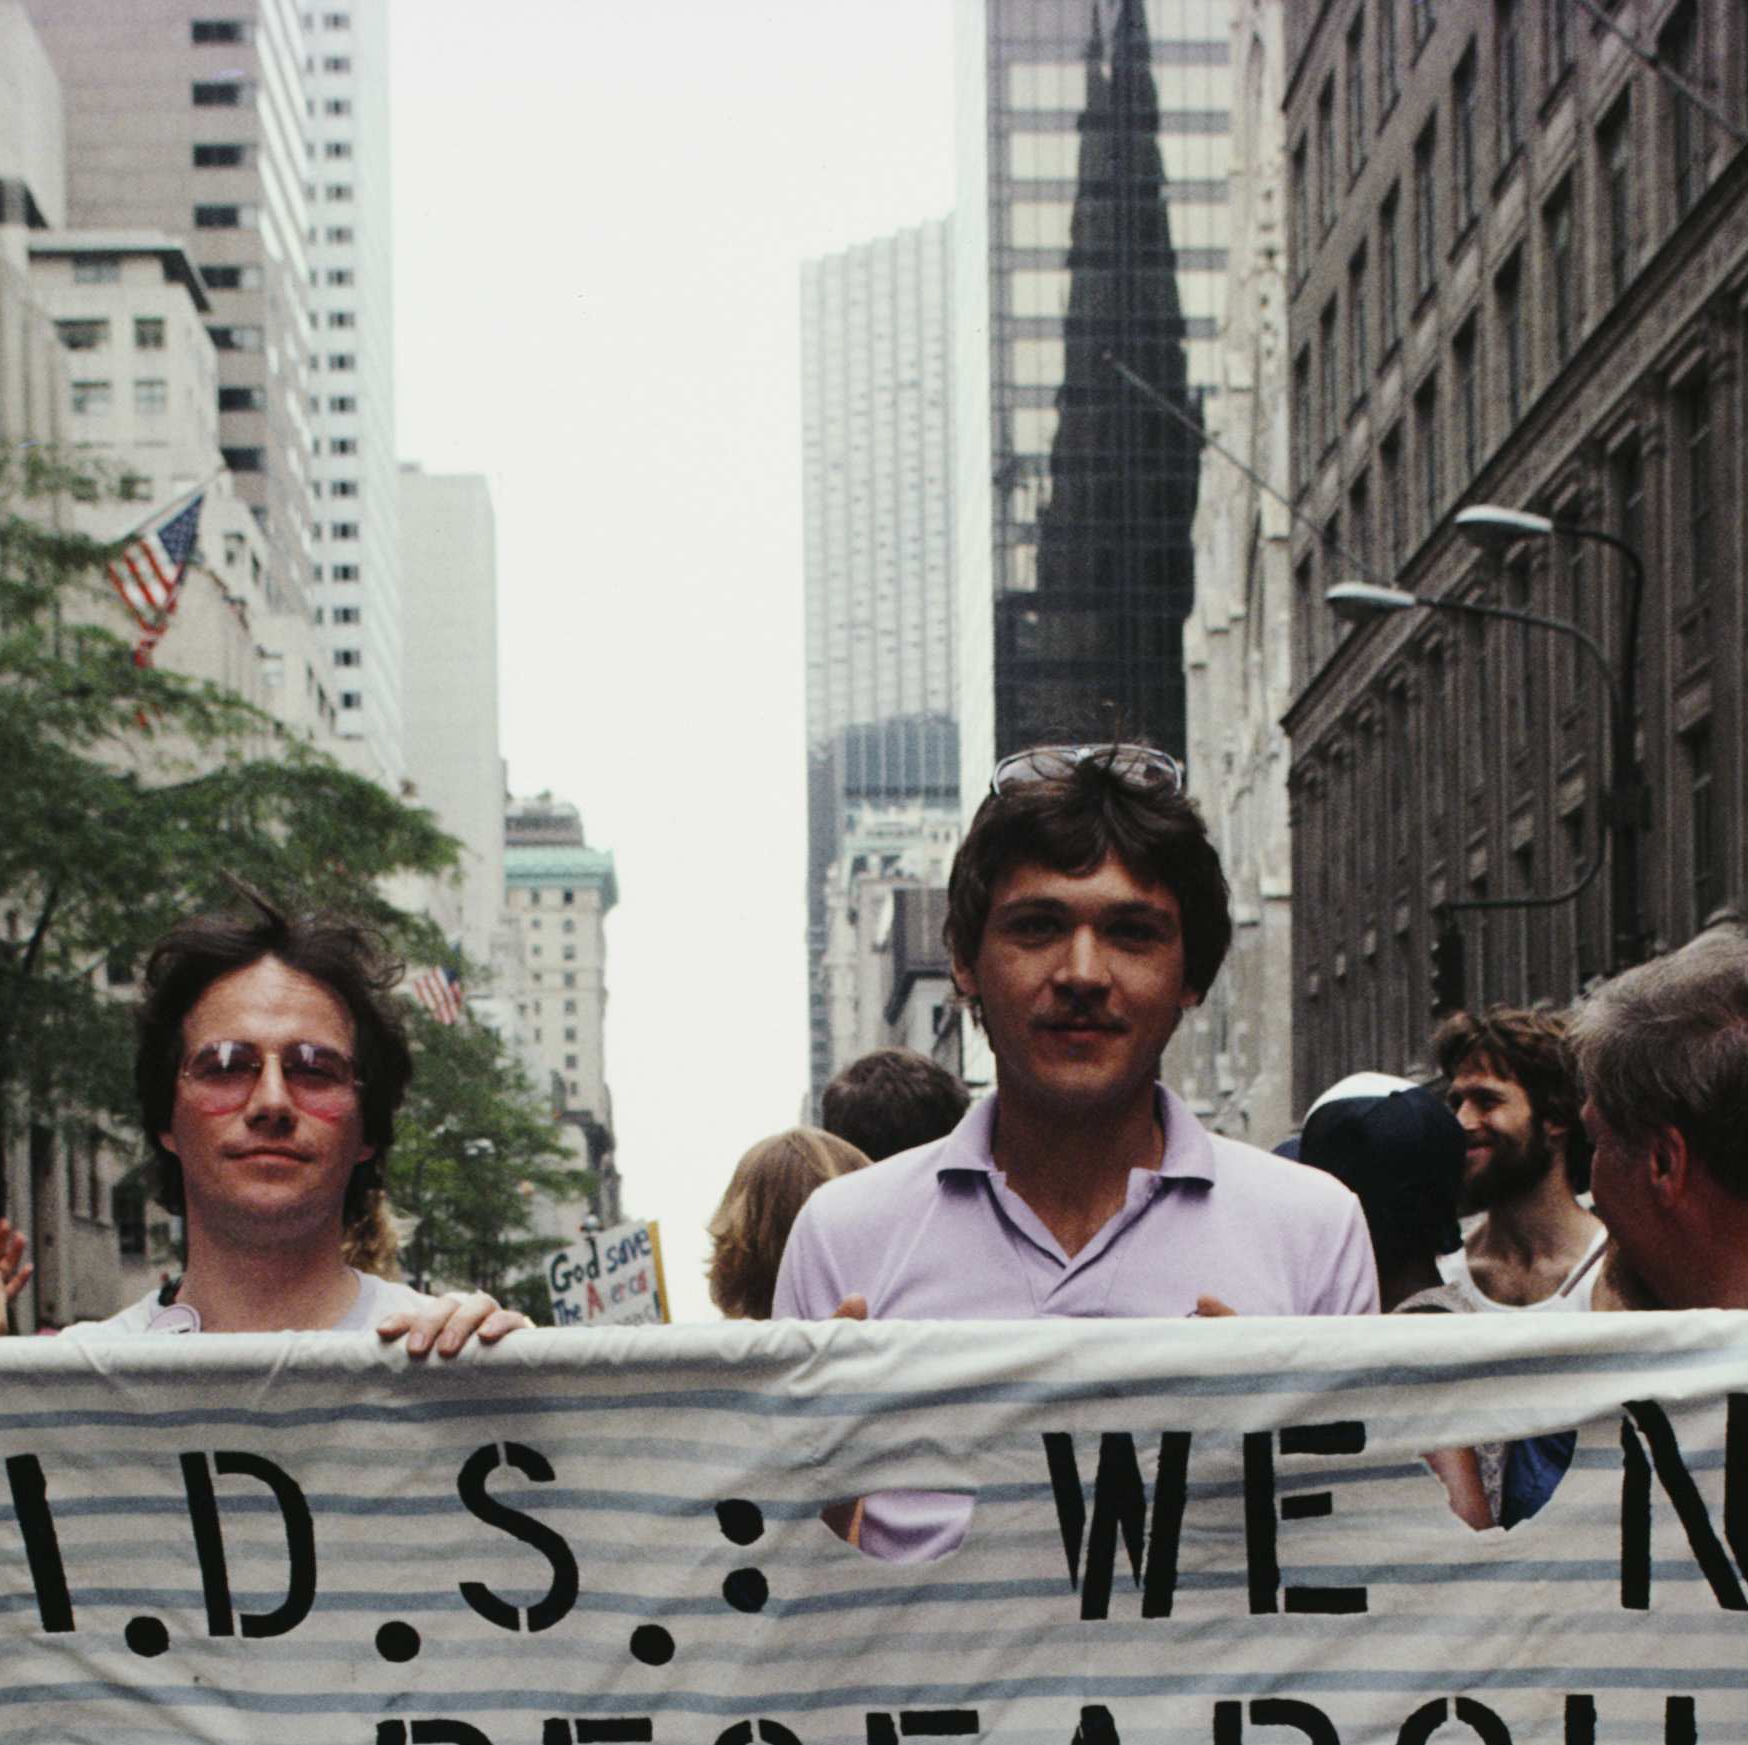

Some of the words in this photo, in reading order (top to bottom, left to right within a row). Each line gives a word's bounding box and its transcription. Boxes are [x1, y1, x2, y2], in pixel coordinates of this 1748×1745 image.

[550, 1235, 600, 1293] God
[605, 1228, 652, 1274] save
[1043, 1421, 1368, 1620] WE
